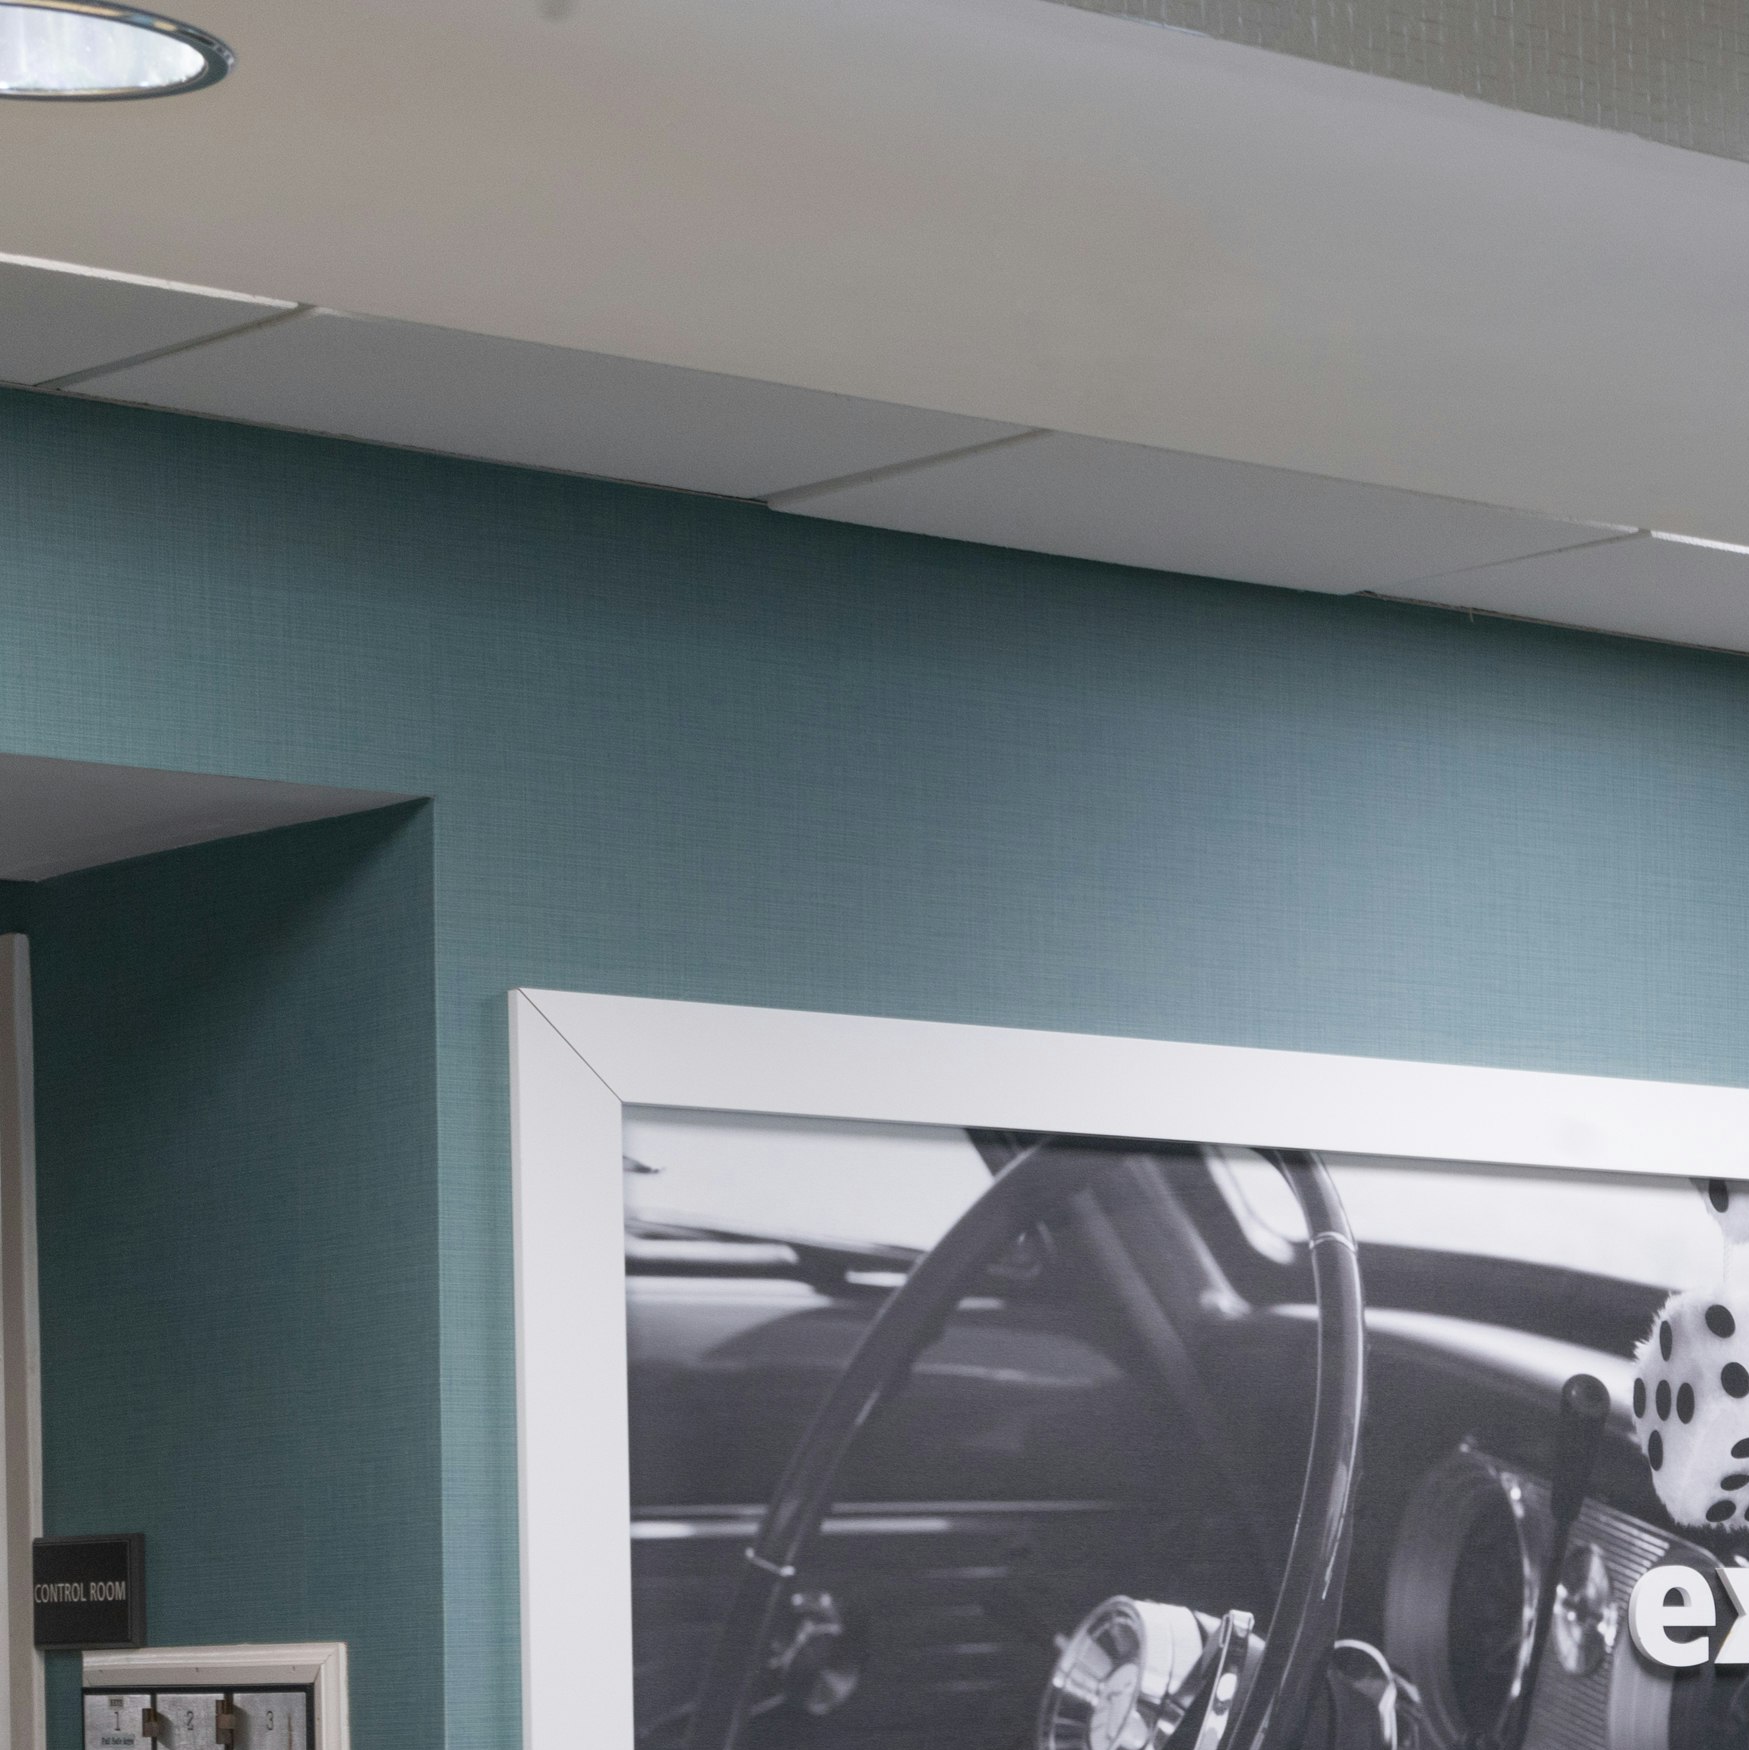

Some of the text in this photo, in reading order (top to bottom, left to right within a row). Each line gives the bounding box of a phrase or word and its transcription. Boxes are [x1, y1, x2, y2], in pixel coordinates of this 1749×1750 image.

[34, 1581, 126, 1603] CONTROL ROOM
[114, 1711, 121, 1731] 1
[186, 1710, 194, 1731] 2
[266, 1710, 274, 1731] 3
